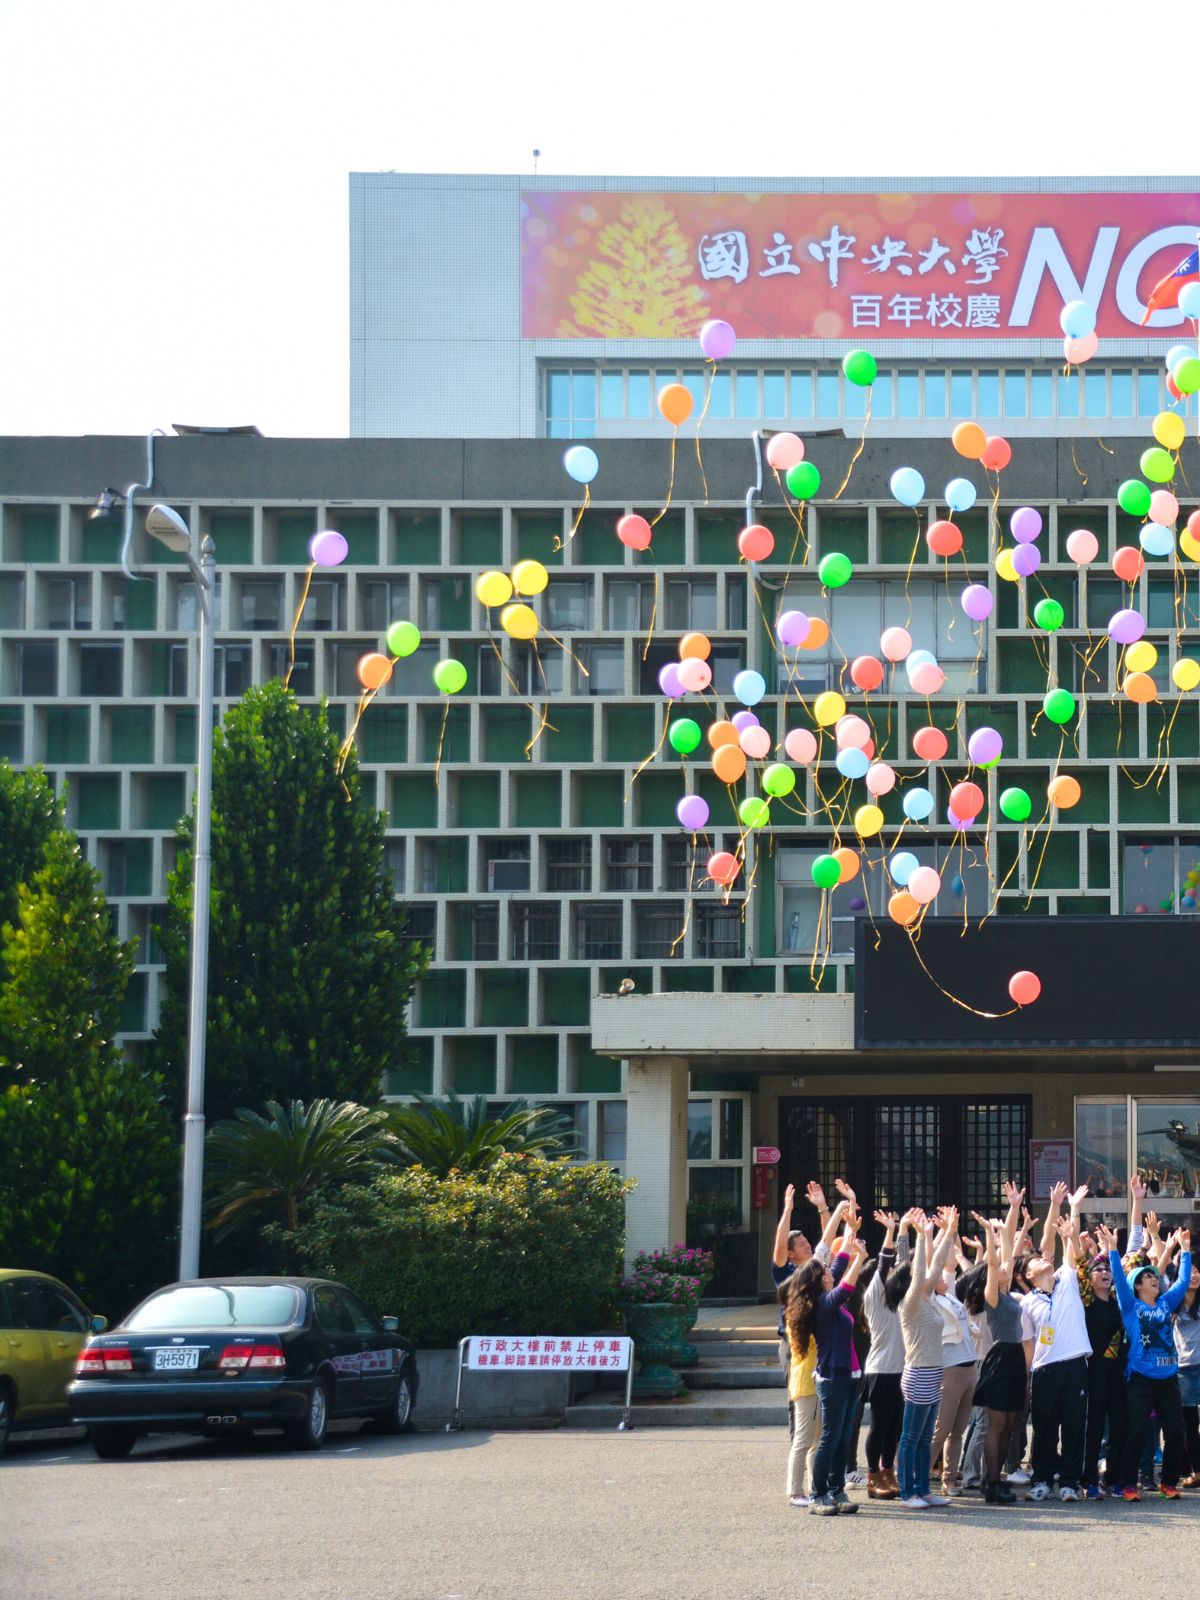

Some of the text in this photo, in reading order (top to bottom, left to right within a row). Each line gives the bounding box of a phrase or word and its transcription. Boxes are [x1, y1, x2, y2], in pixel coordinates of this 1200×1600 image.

[698, 225, 1009, 288] 國立中央大學
[850, 294, 1001, 328] 百年校慶
[479, 1339, 621, 1353] 行政大樓前禁止停車
